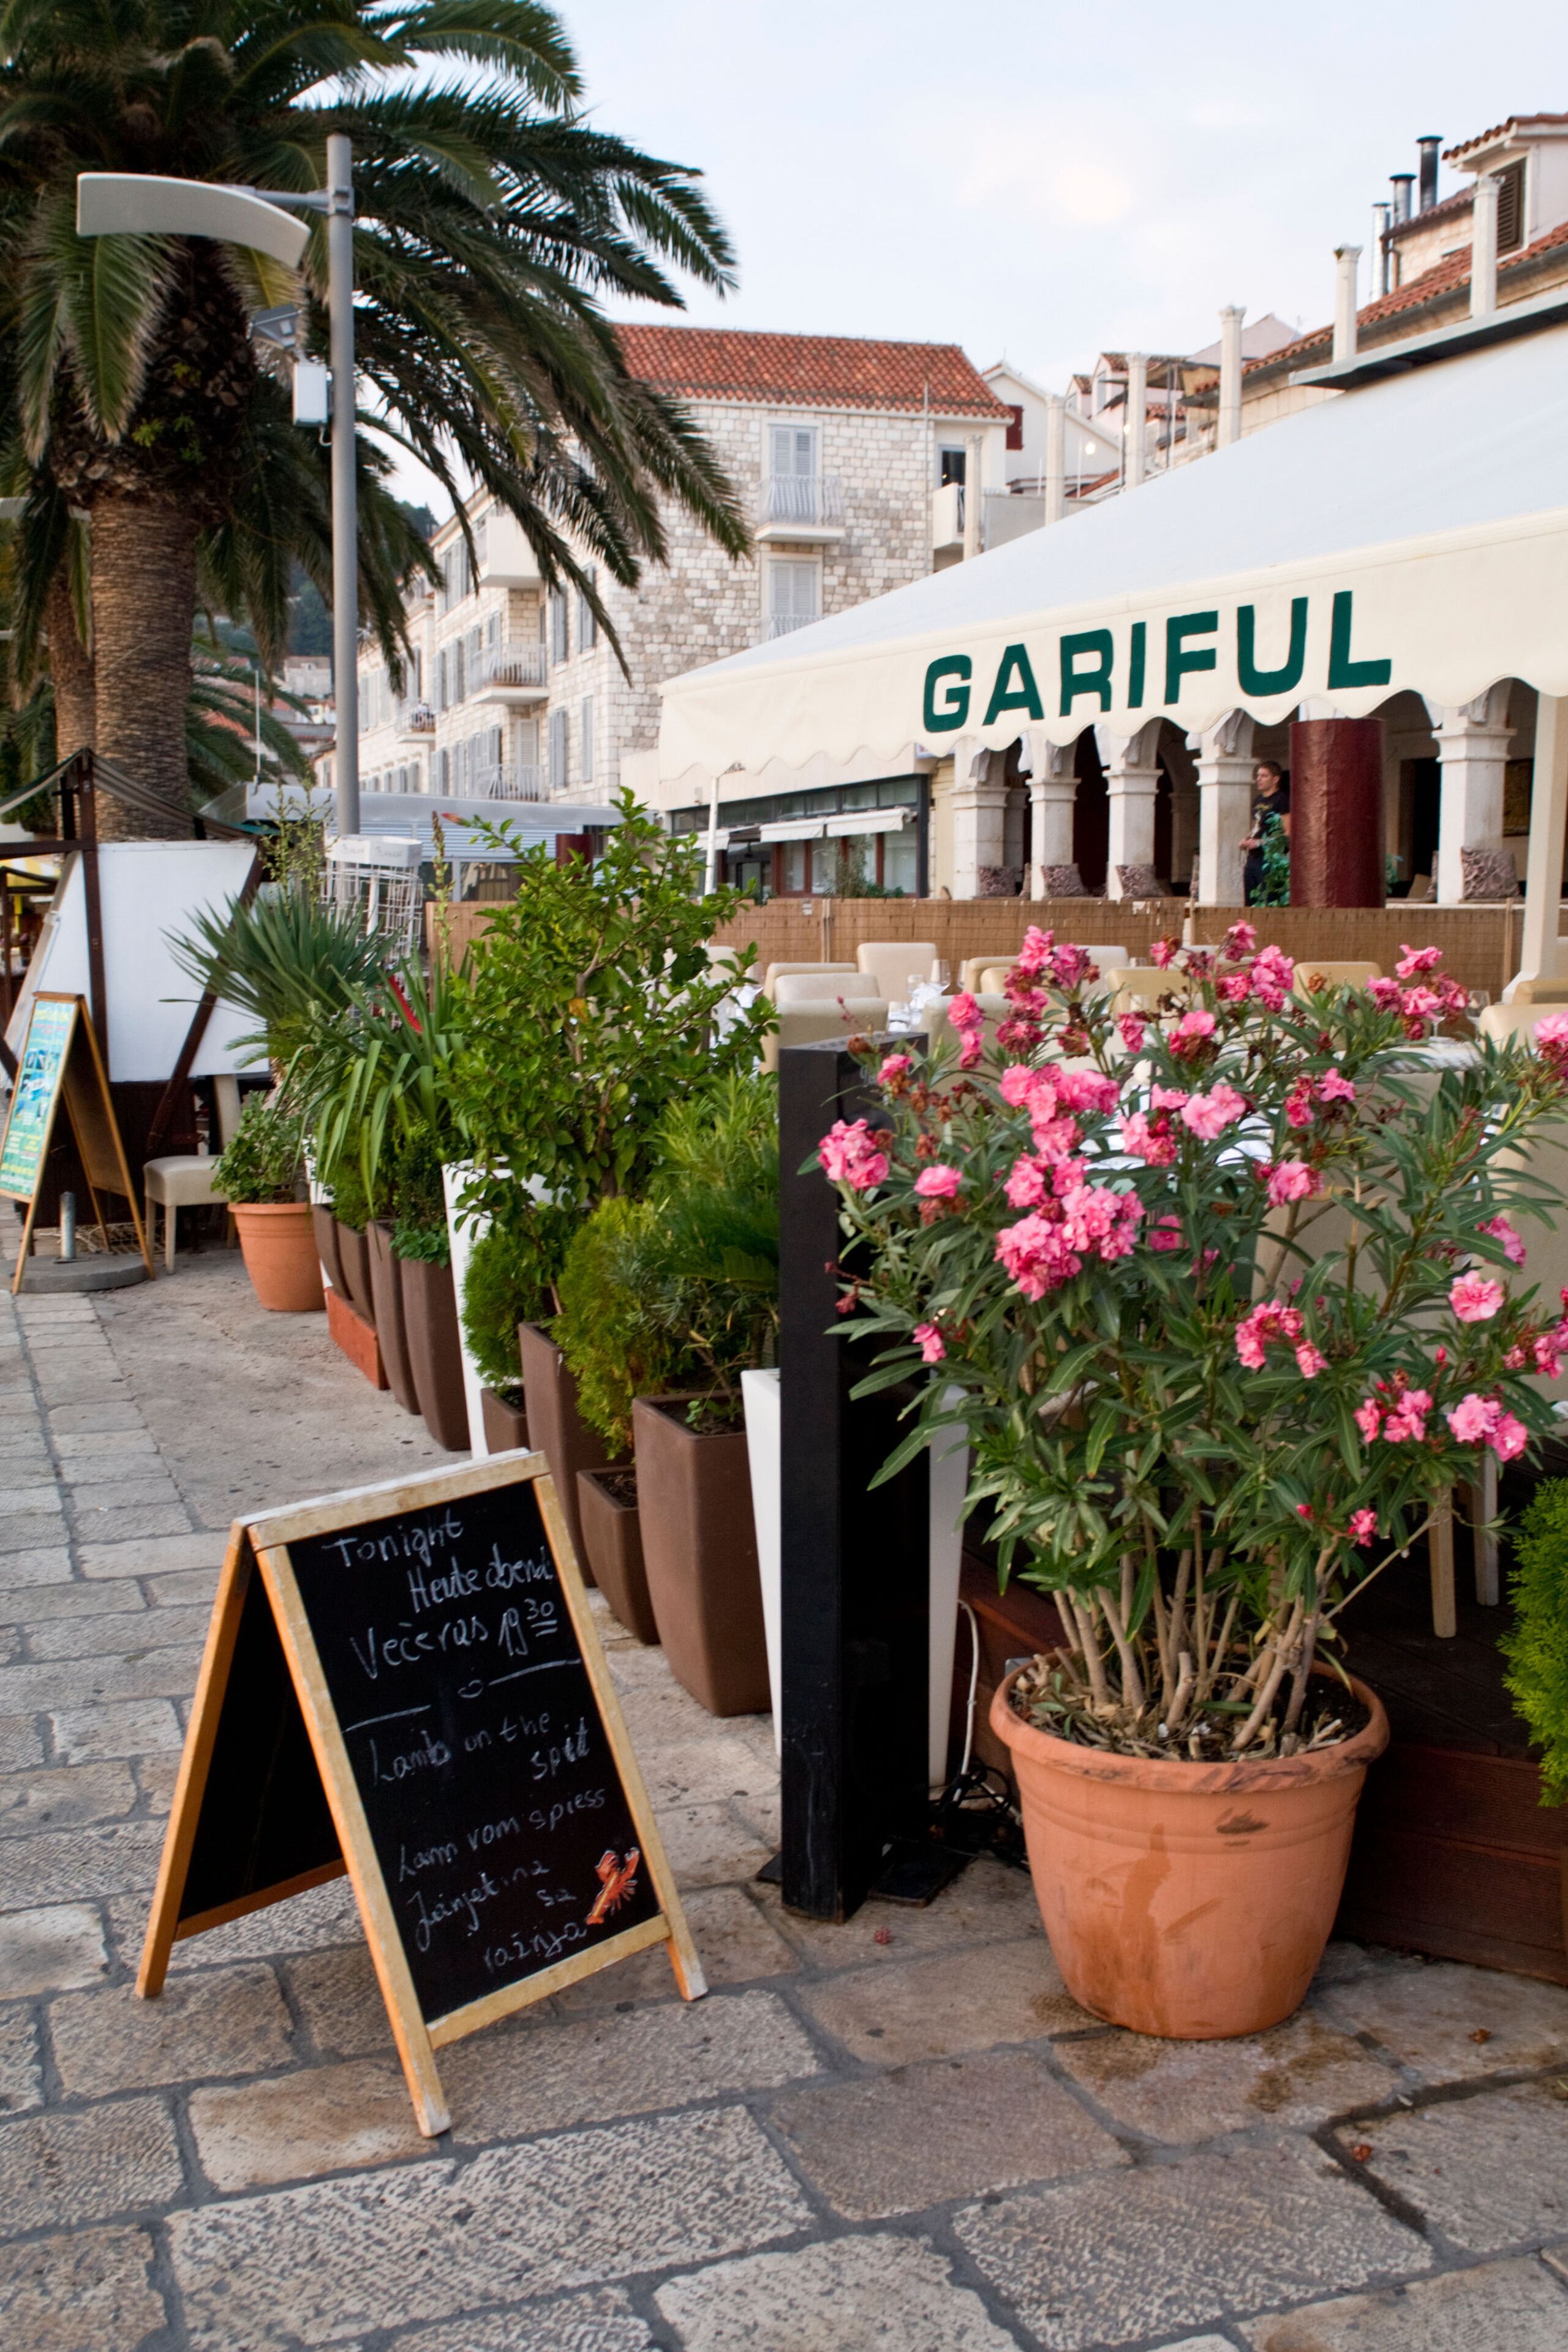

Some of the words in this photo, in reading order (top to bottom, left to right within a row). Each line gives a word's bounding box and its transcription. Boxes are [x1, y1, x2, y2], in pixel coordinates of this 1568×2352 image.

[923, 590, 1392, 733] GARIFUL
[322, 1507, 464, 1568] Tonight
[407, 1555, 484, 1613] Heute
[369, 1730, 452, 1785] Lamb
[464, 1730, 491, 1752] on
[499, 1713, 550, 1742] the
[467, 1817, 521, 1852] vom
